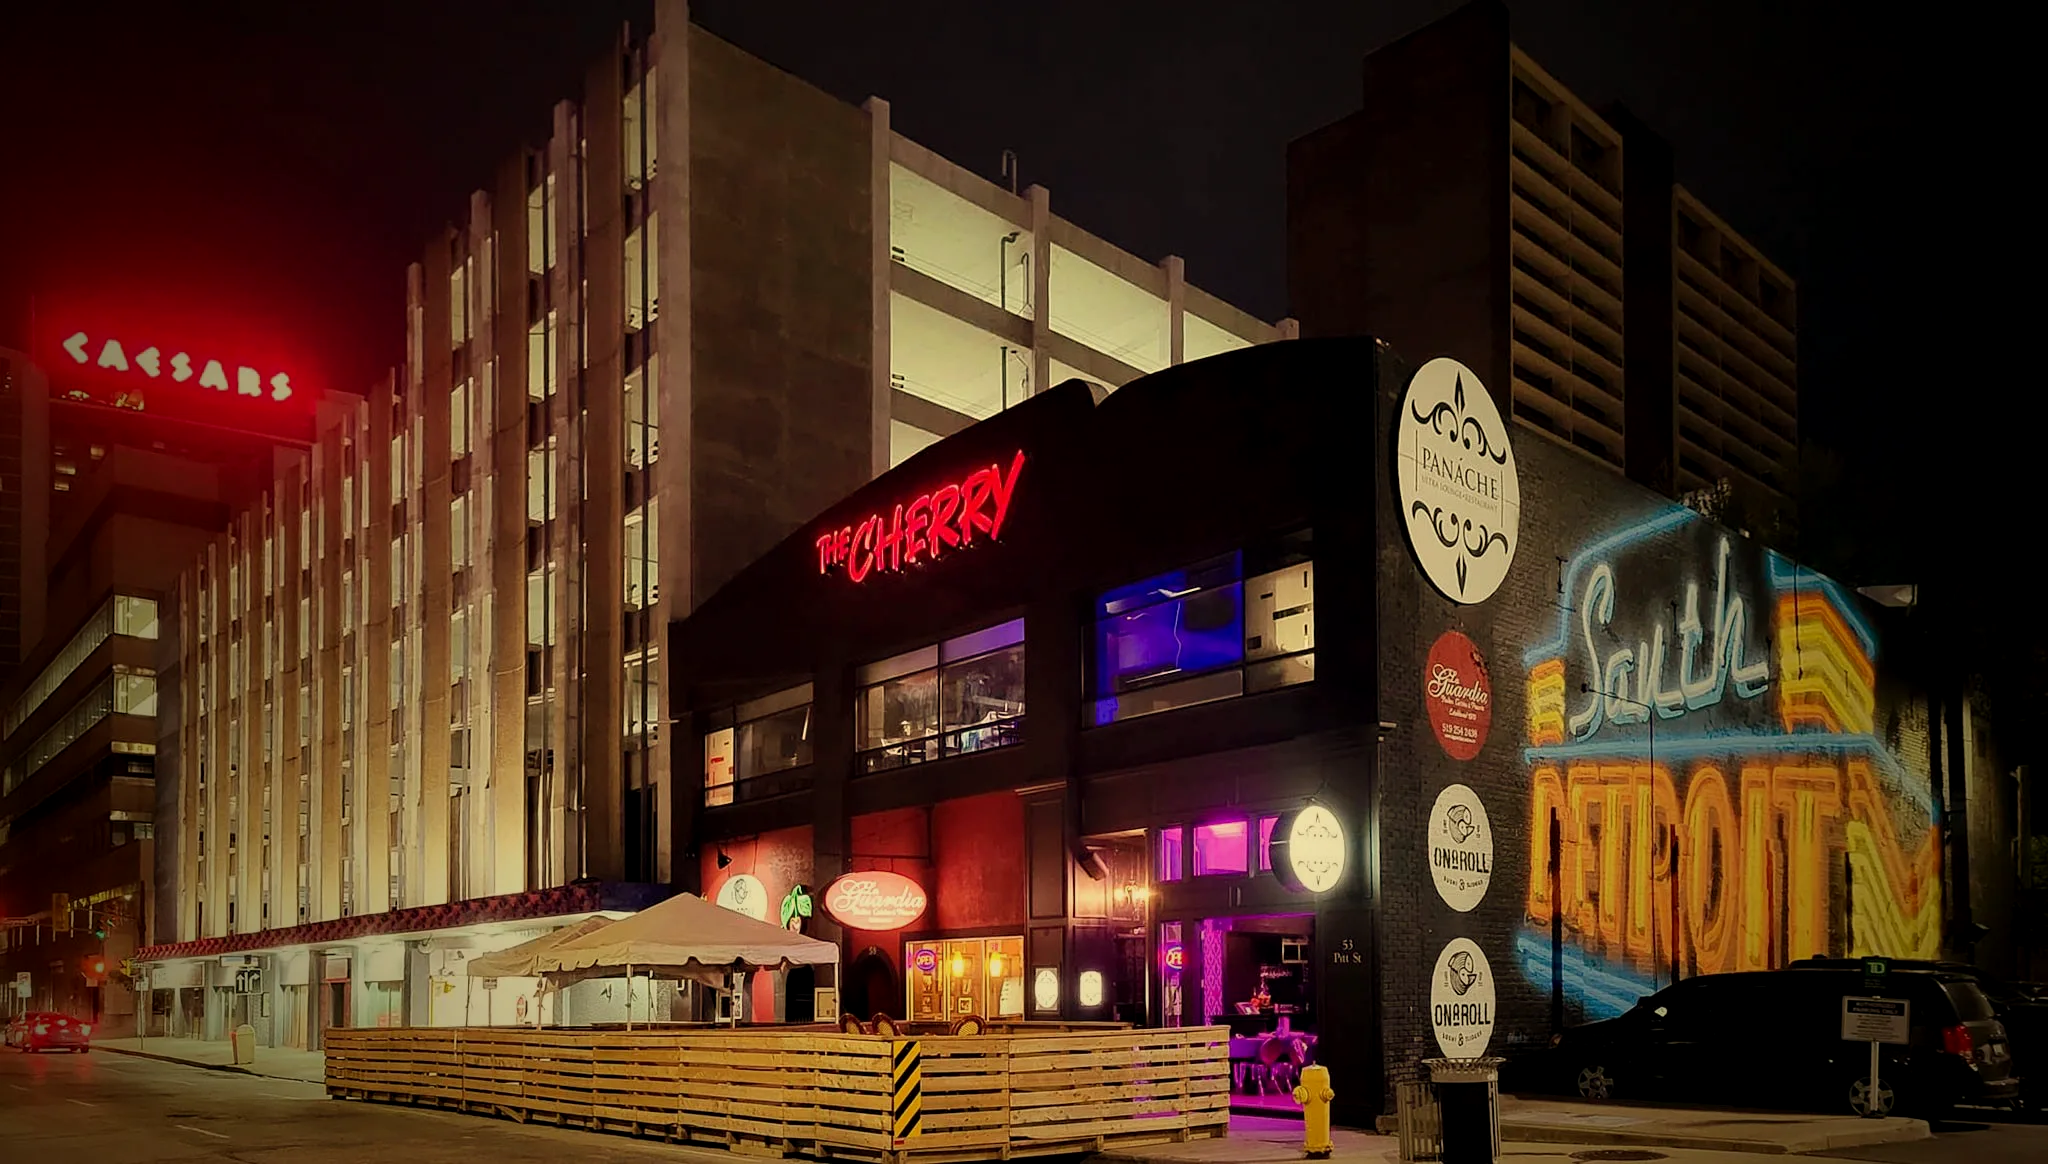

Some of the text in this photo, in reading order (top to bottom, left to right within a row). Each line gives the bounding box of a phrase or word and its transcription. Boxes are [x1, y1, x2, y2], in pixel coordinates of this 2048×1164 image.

[63, 331, 293, 401] CAESARS
[816, 449, 1025, 583] THE CHERRY
[1342, 939, 1354, 951] 53
[1333, 951, 1362, 963] Pitt St
[1867, 962, 1885, 974] TD
